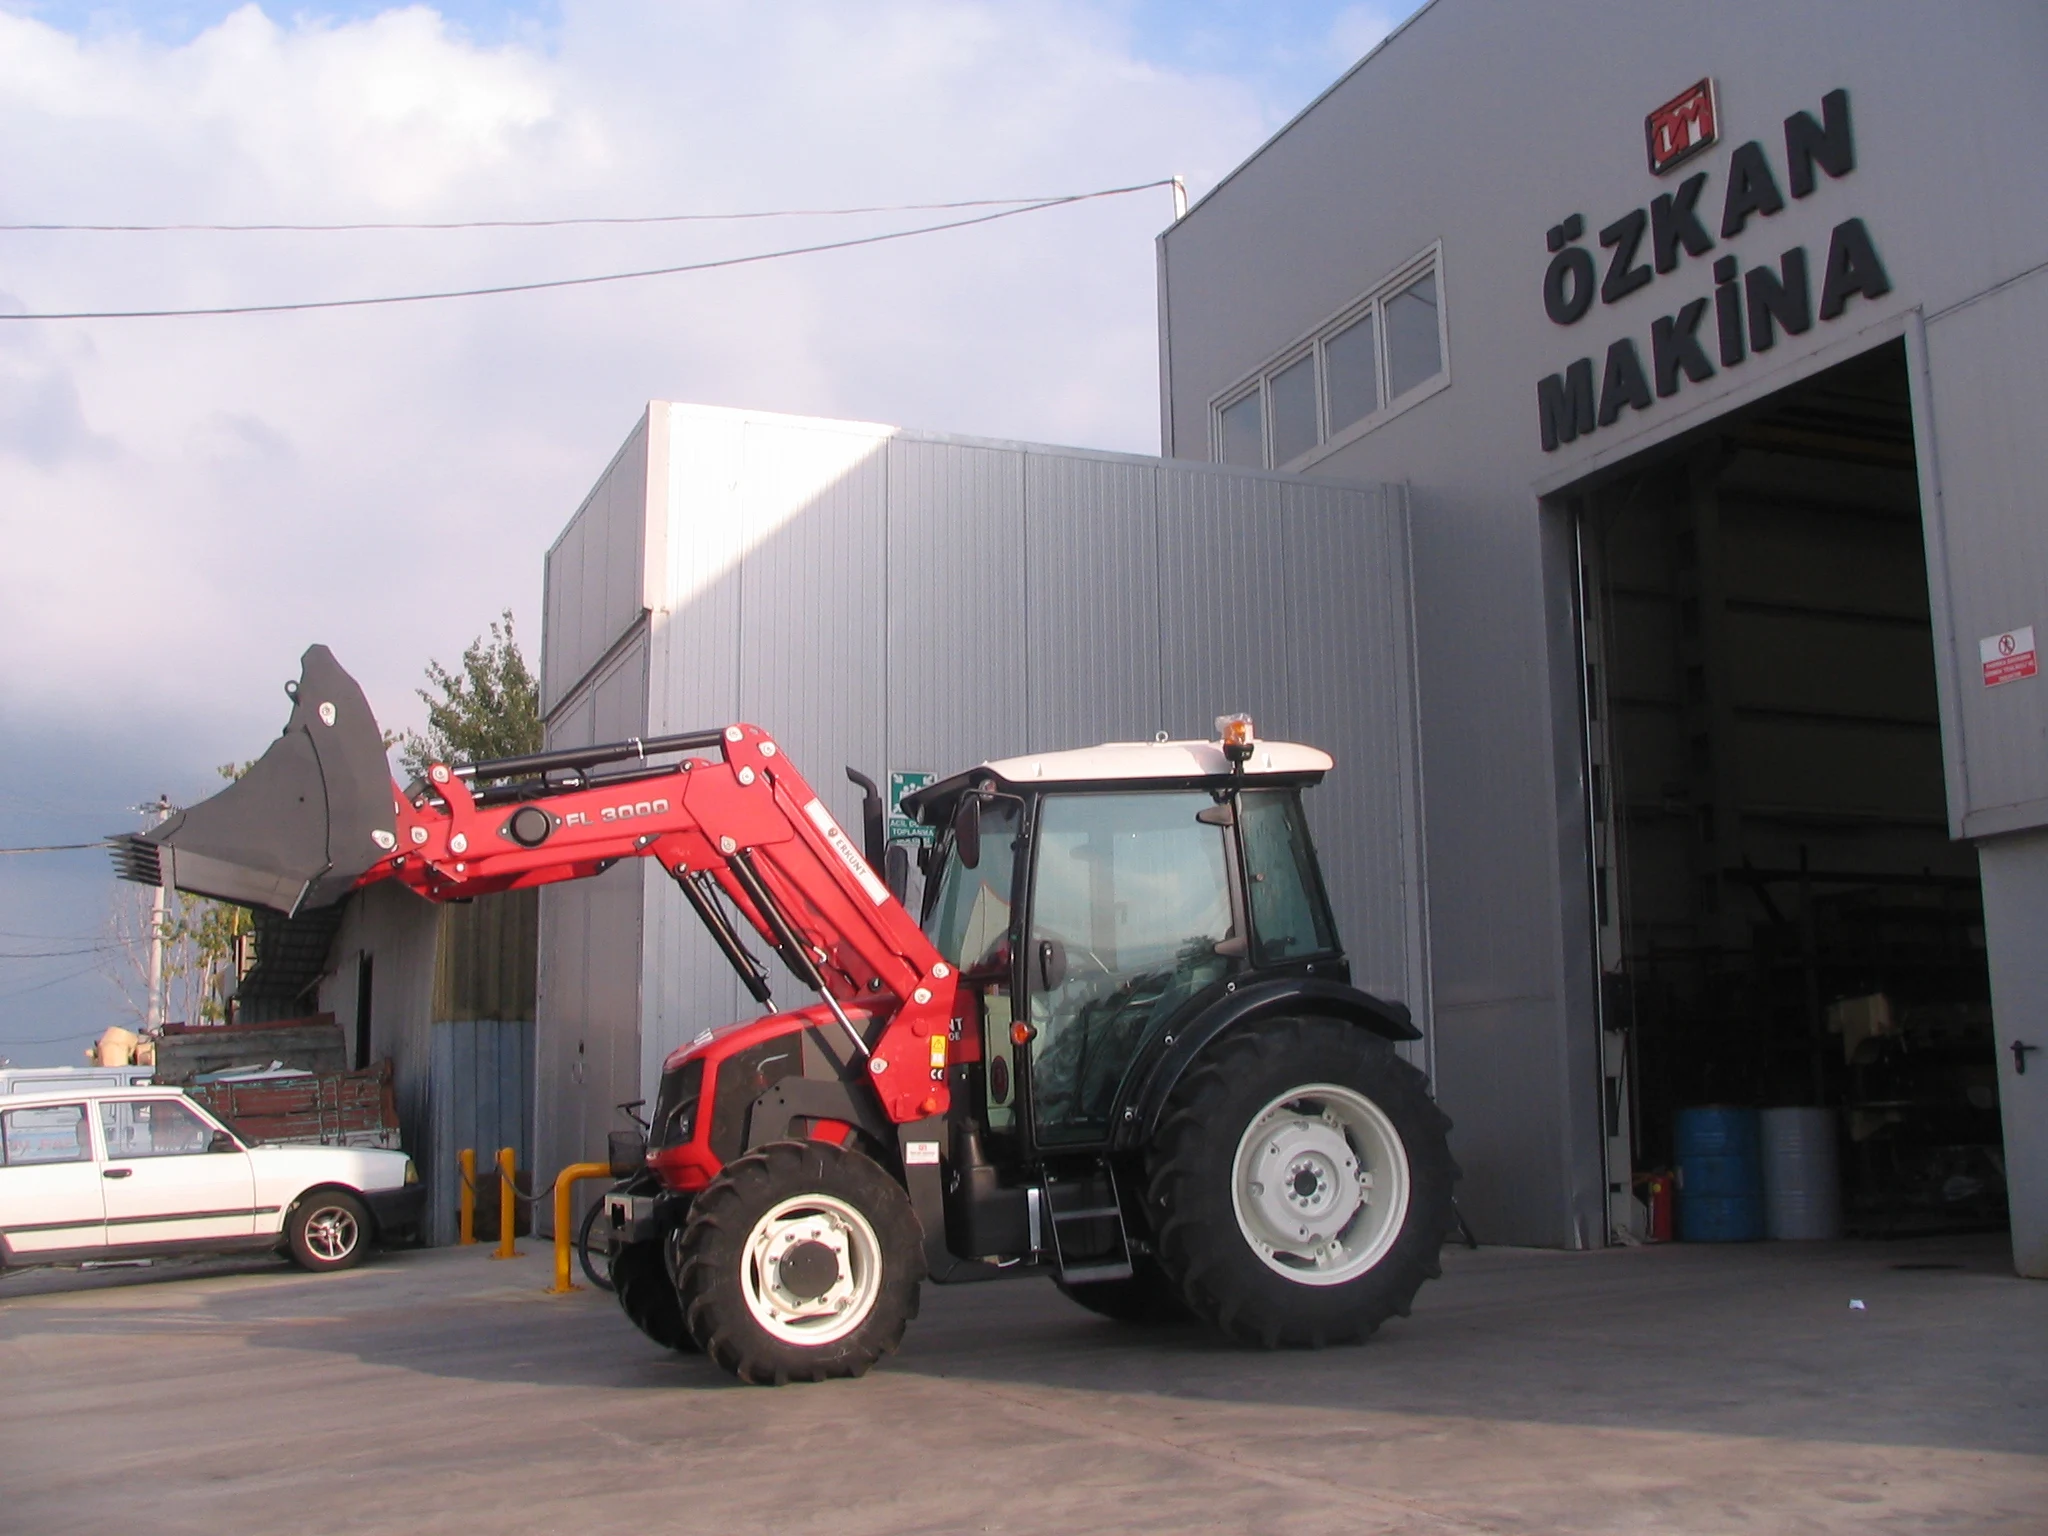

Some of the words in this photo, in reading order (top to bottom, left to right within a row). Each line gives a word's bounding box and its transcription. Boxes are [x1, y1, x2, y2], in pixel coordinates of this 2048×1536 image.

[1543, 88, 1855, 326] ÖZKAN
[1537, 218, 1892, 452] MAKİNA
[565, 812, 594, 827] FL
[601, 799, 669, 822] 3000
[892, 828, 934, 837] TOPLANMA
[836, 839, 866, 875] ERKUNT
